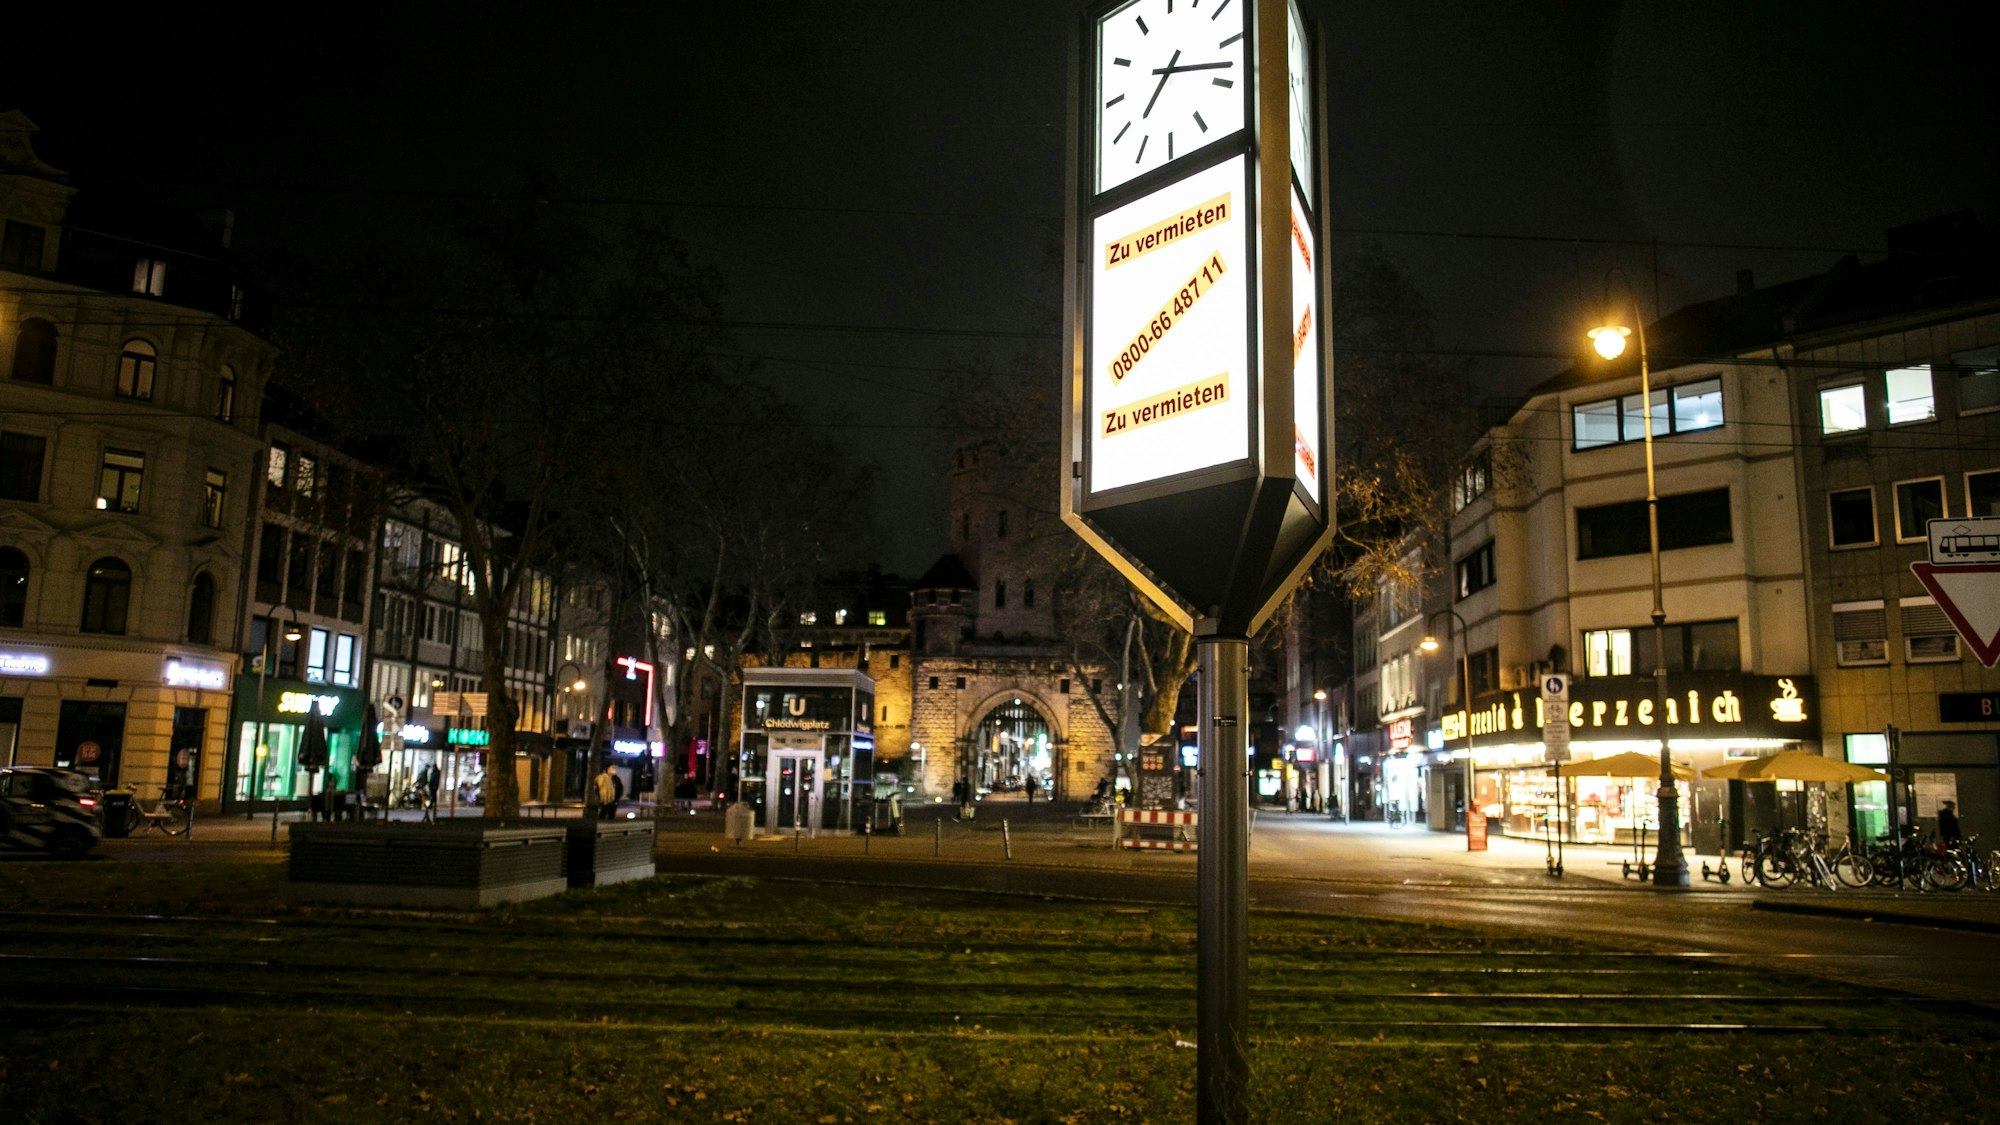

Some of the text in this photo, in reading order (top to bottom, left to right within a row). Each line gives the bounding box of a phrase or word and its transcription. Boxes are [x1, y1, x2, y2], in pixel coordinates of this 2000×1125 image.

[1109, 202, 1227, 265] Zu vermieten
[1112, 255, 1225, 381] 0800-66 487 11
[1105, 381, 1225, 435] Zu vermieten
[765, 718, 830, 731] Chlodwigplatz
[789, 698, 806, 716] U
